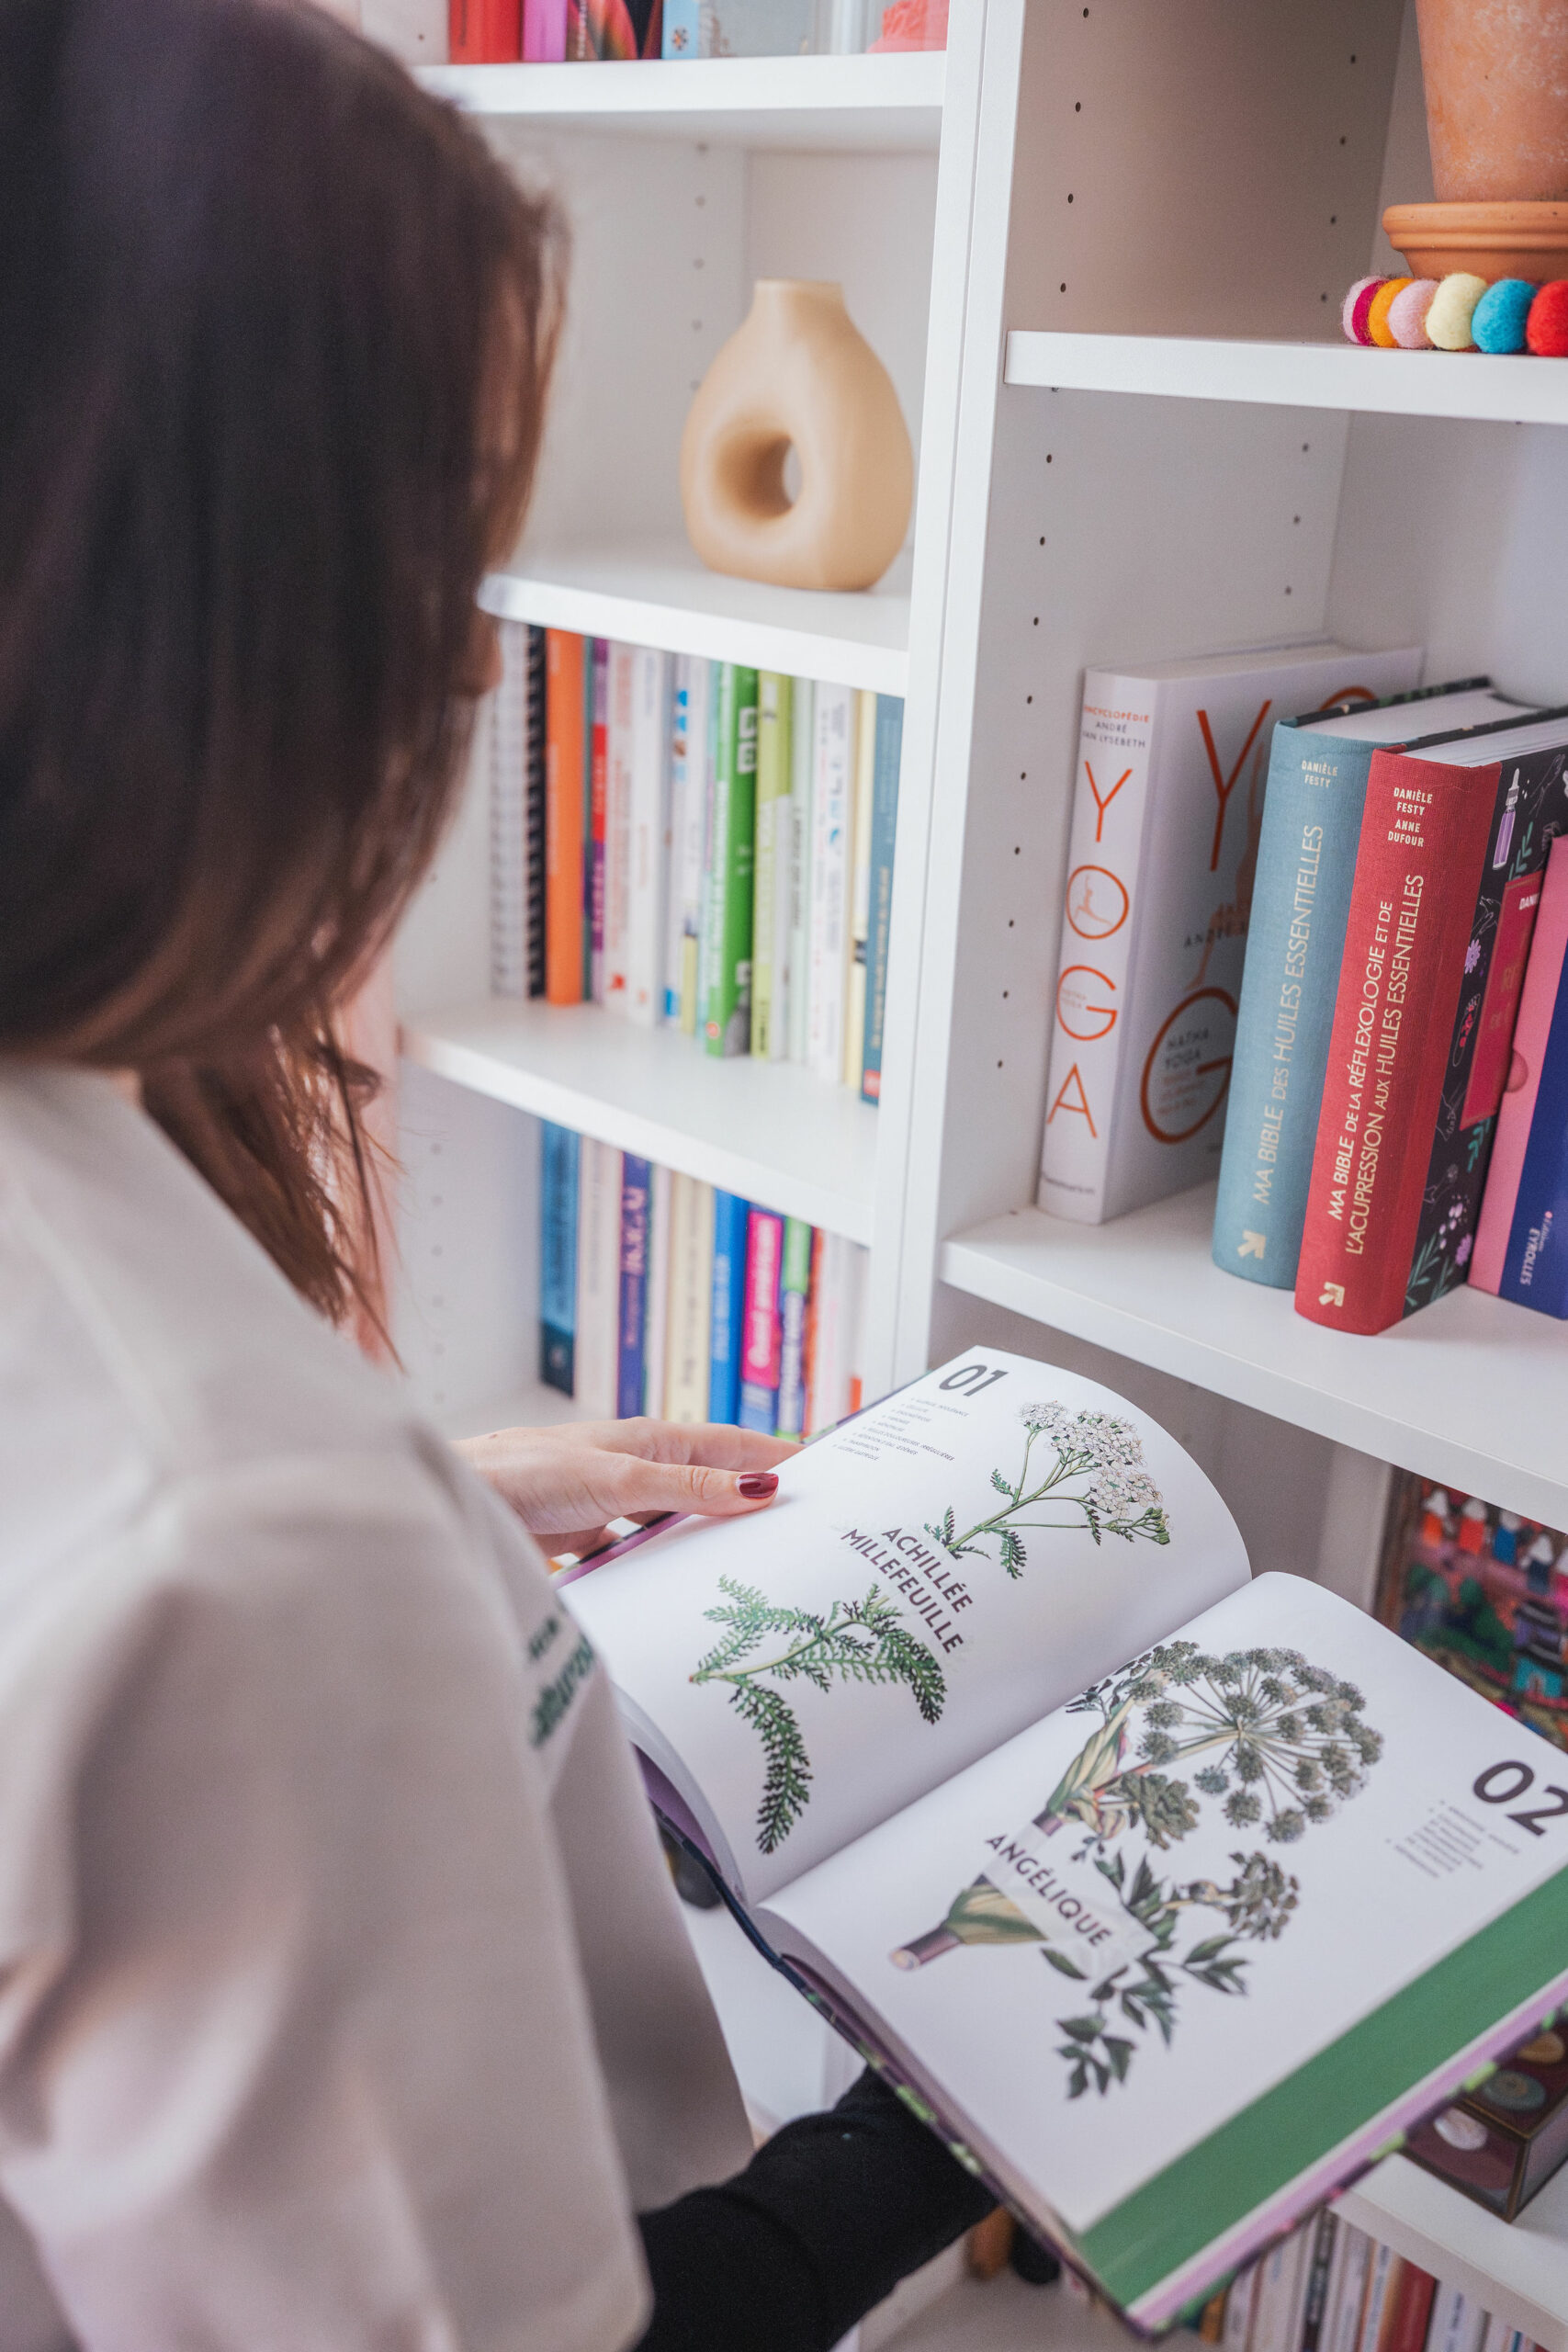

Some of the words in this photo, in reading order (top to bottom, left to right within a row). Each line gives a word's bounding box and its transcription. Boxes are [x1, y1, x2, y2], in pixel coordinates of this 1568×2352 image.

[1096, 720, 1127, 734] ANDRÉ
[1302, 760, 1338, 776] DANIÈLE
[1304, 775, 1331, 788] FESTY
[1393, 786, 1433, 804] DANIÈLE
[1396, 801, 1426, 816] FESTY
[1387, 831, 1425, 847] DUFOUR
[1394, 819, 1421, 833] ANNE
[1285, 825, 1324, 978] ESSENTIELLES
[1378, 900, 1393, 923] DE
[1047, 759, 1134, 1138] YOGA
[1375, 924, 1389, 944] ET
[1386, 874, 1424, 1004] ESSENTIELLES
[1273, 983, 1302, 1061] HUILES
[1347, 945, 1385, 1089] RÉFLEXOLOGIE
[1375, 1007, 1403, 1075] HUILES
[1271, 1067, 1290, 1100] DES
[1375, 1080, 1391, 1111] AUX
[1348, 1092, 1362, 1110] LA
[1258, 1104, 1283, 1163] BIBLE
[1345, 1111, 1359, 1133] DE
[1333, 1136, 1355, 1185] BIBLE
[1253, 1168, 1274, 1205] MA
[1327, 1189, 1347, 1221] MA
[939, 1364, 1009, 1396] 01
[882, 1528, 974, 1613] ACHILLÉE
[840, 1528, 964, 1654] MILLEFEUILLE
[1472, 1759, 1568, 1837] 02
[985, 1834, 1112, 1947] ANGÉLIQUE
